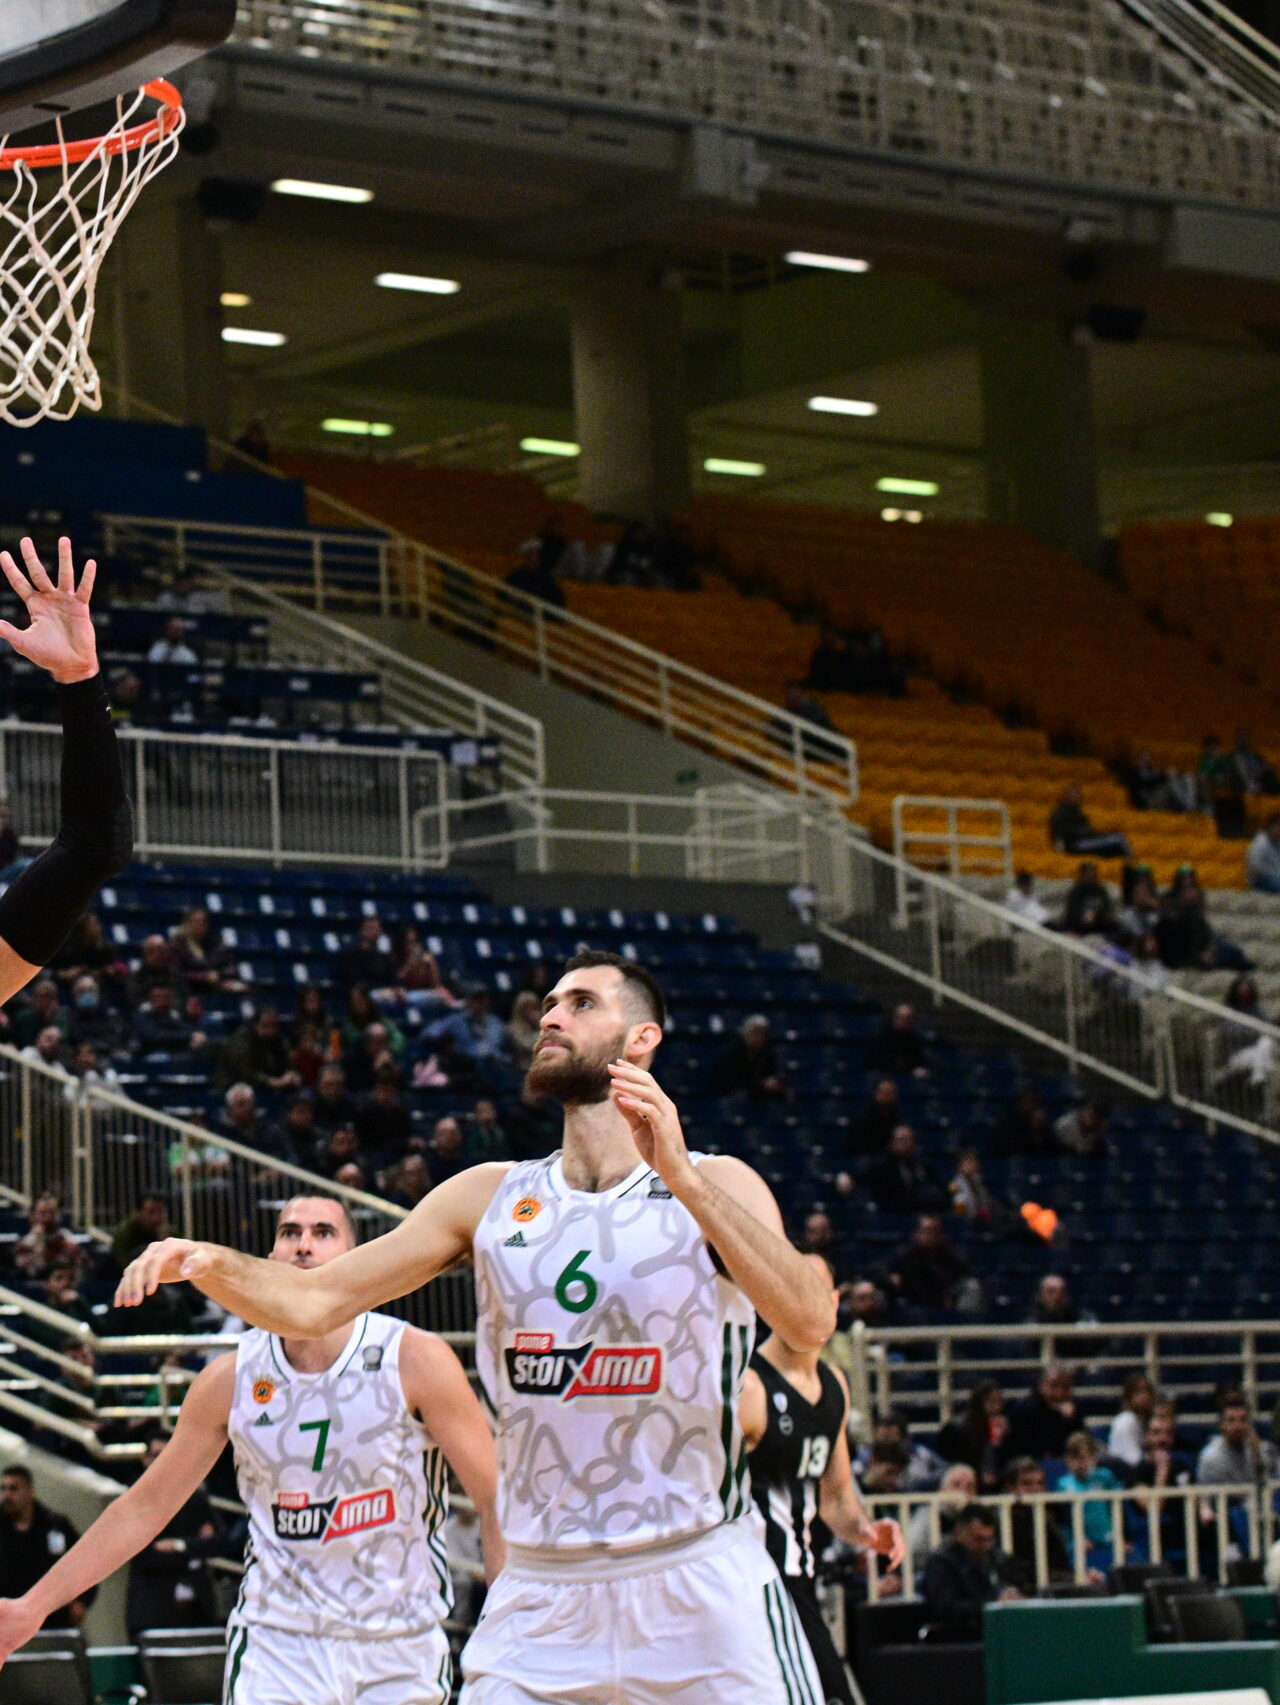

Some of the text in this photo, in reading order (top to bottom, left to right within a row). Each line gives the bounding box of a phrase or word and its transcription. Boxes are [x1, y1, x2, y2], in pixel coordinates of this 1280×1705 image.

[554, 1250, 597, 1314] 6
[299, 1418, 331, 1473] 7
[796, 1434, 831, 1479] 13
